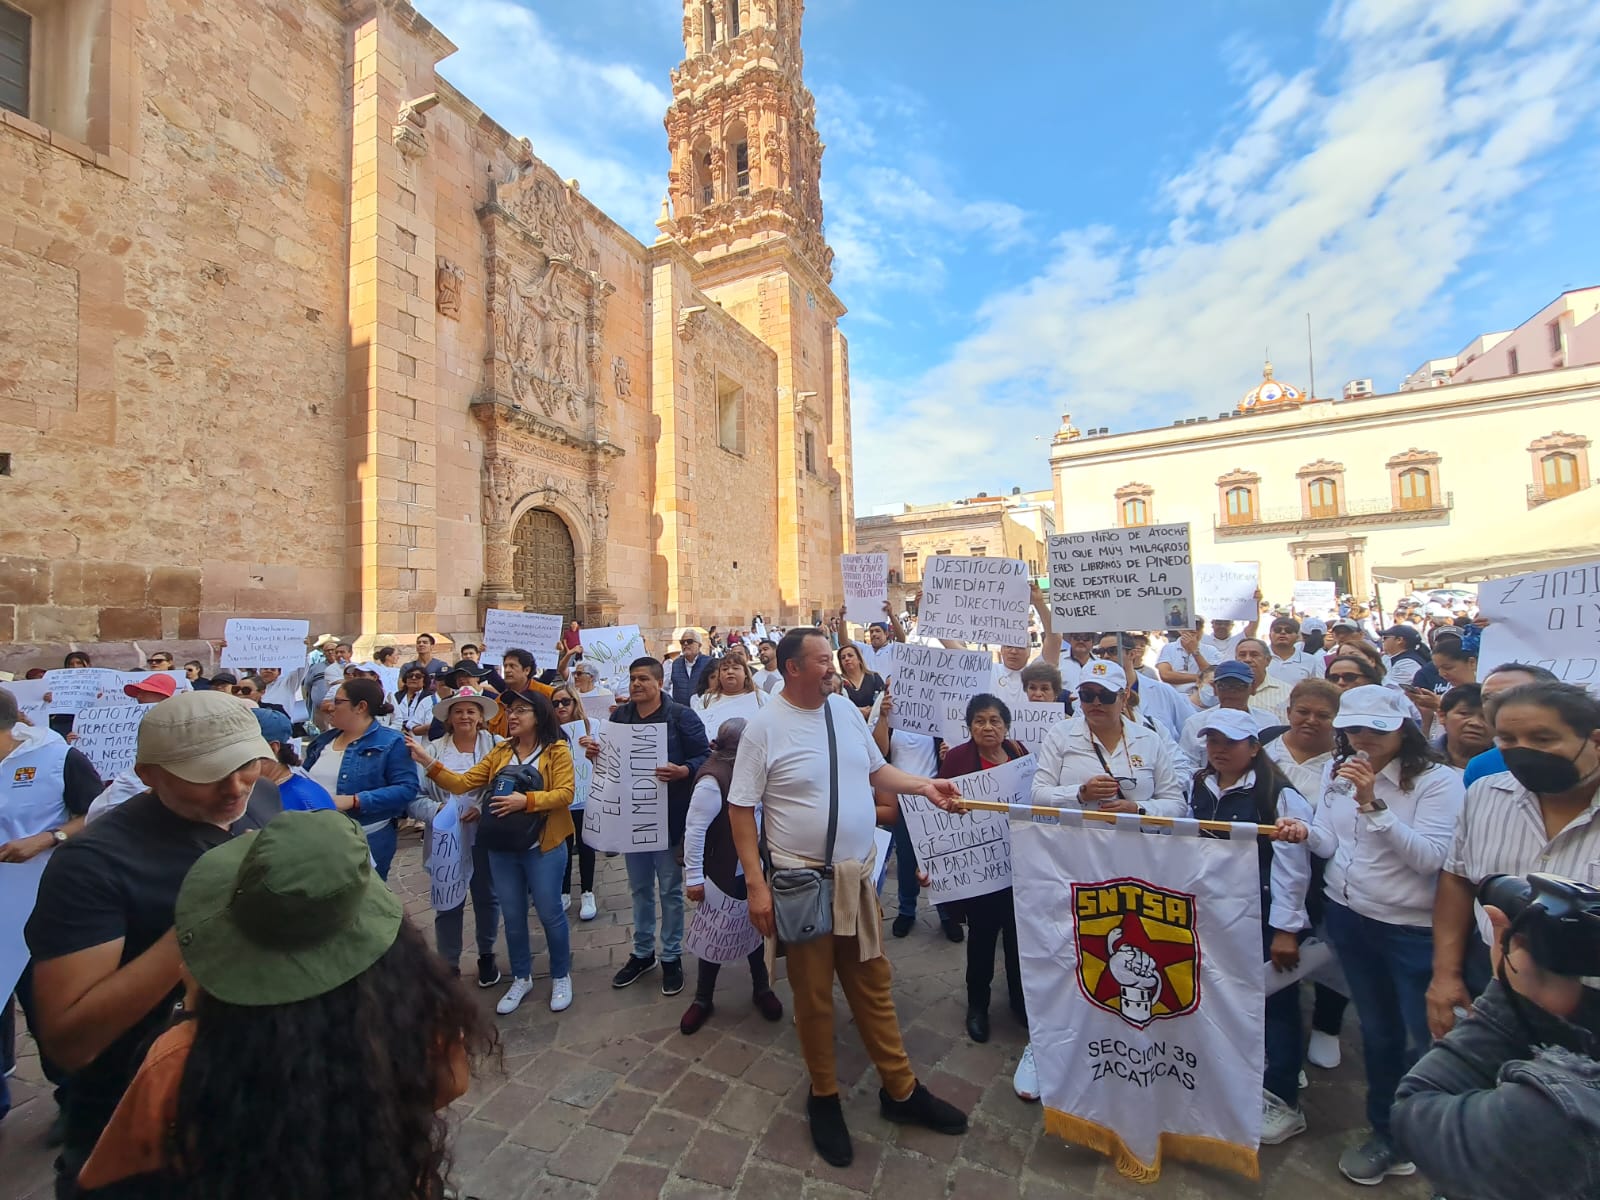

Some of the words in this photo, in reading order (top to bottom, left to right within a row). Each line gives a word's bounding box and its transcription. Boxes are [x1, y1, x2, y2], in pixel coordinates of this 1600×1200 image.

[1050, 535, 1085, 546] SANTO
[1091, 531, 1120, 543] NIÑO
[1128, 531, 1141, 541] DE
[1148, 527, 1189, 537] ATOCHA
[1052, 551, 1067, 560] TU
[1072, 549, 1093, 559] QUE
[1130, 542, 1190, 554] MILAGROSO
[1053, 563, 1074, 574] ERES
[1081, 560, 1122, 572] LIBRANOS
[1126, 559, 1141, 568] DE
[1146, 555, 1192, 568] PINEDO
[932, 576, 1005, 595] INMEDIATA
[1053, 577, 1077, 588] QUE
[1083, 573, 1140, 586] DESTRUIR
[1150, 572, 1167, 583] LA
[926, 592, 941, 605] DE
[955, 595, 1025, 613] DIRECTIVOS
[1053, 588, 1110, 602] SECRETARIA
[1116, 588, 1132, 598] DE
[1137, 586, 1183, 598] SALUD
[925, 610, 940, 622] DE
[946, 612, 964, 626] LOS
[970, 614, 1025, 630] HOSPITALES
[919, 624, 969, 639] ZACATECAS
[583, 640, 613, 664] NO
[895, 646, 932, 666] BASTA
[937, 651, 955, 670] DE
[900, 666, 916, 681] POR
[919, 669, 978, 688] DIRECTIVOS
[893, 681, 914, 698] QUE
[920, 688, 935, 700] NO
[78, 707, 120, 720] COMO
[891, 698, 934, 720] SENTIDO
[902, 718, 922, 730] PARA
[928, 723, 940, 732] EL
[607, 740, 620, 784] 100%
[630, 724, 658, 815] MEDICINAS
[602, 796, 620, 816] EL
[584, 811, 601, 834] ES
[632, 822, 658, 845] EN
[918, 825, 1003, 858] GESTIONEN
[923, 861, 939, 875] YA
[943, 849, 980, 875] BASTA
[982, 844, 1000, 863] DE
[953, 871, 971, 888] NO
[973, 859, 1012, 882] SABEN
[1077, 885, 1188, 926] SNTSA
[1088, 1038, 1166, 1066] SECCION
[1173, 1046, 1198, 1069] 39
[1091, 1060, 1196, 1091] ZACATECAS
